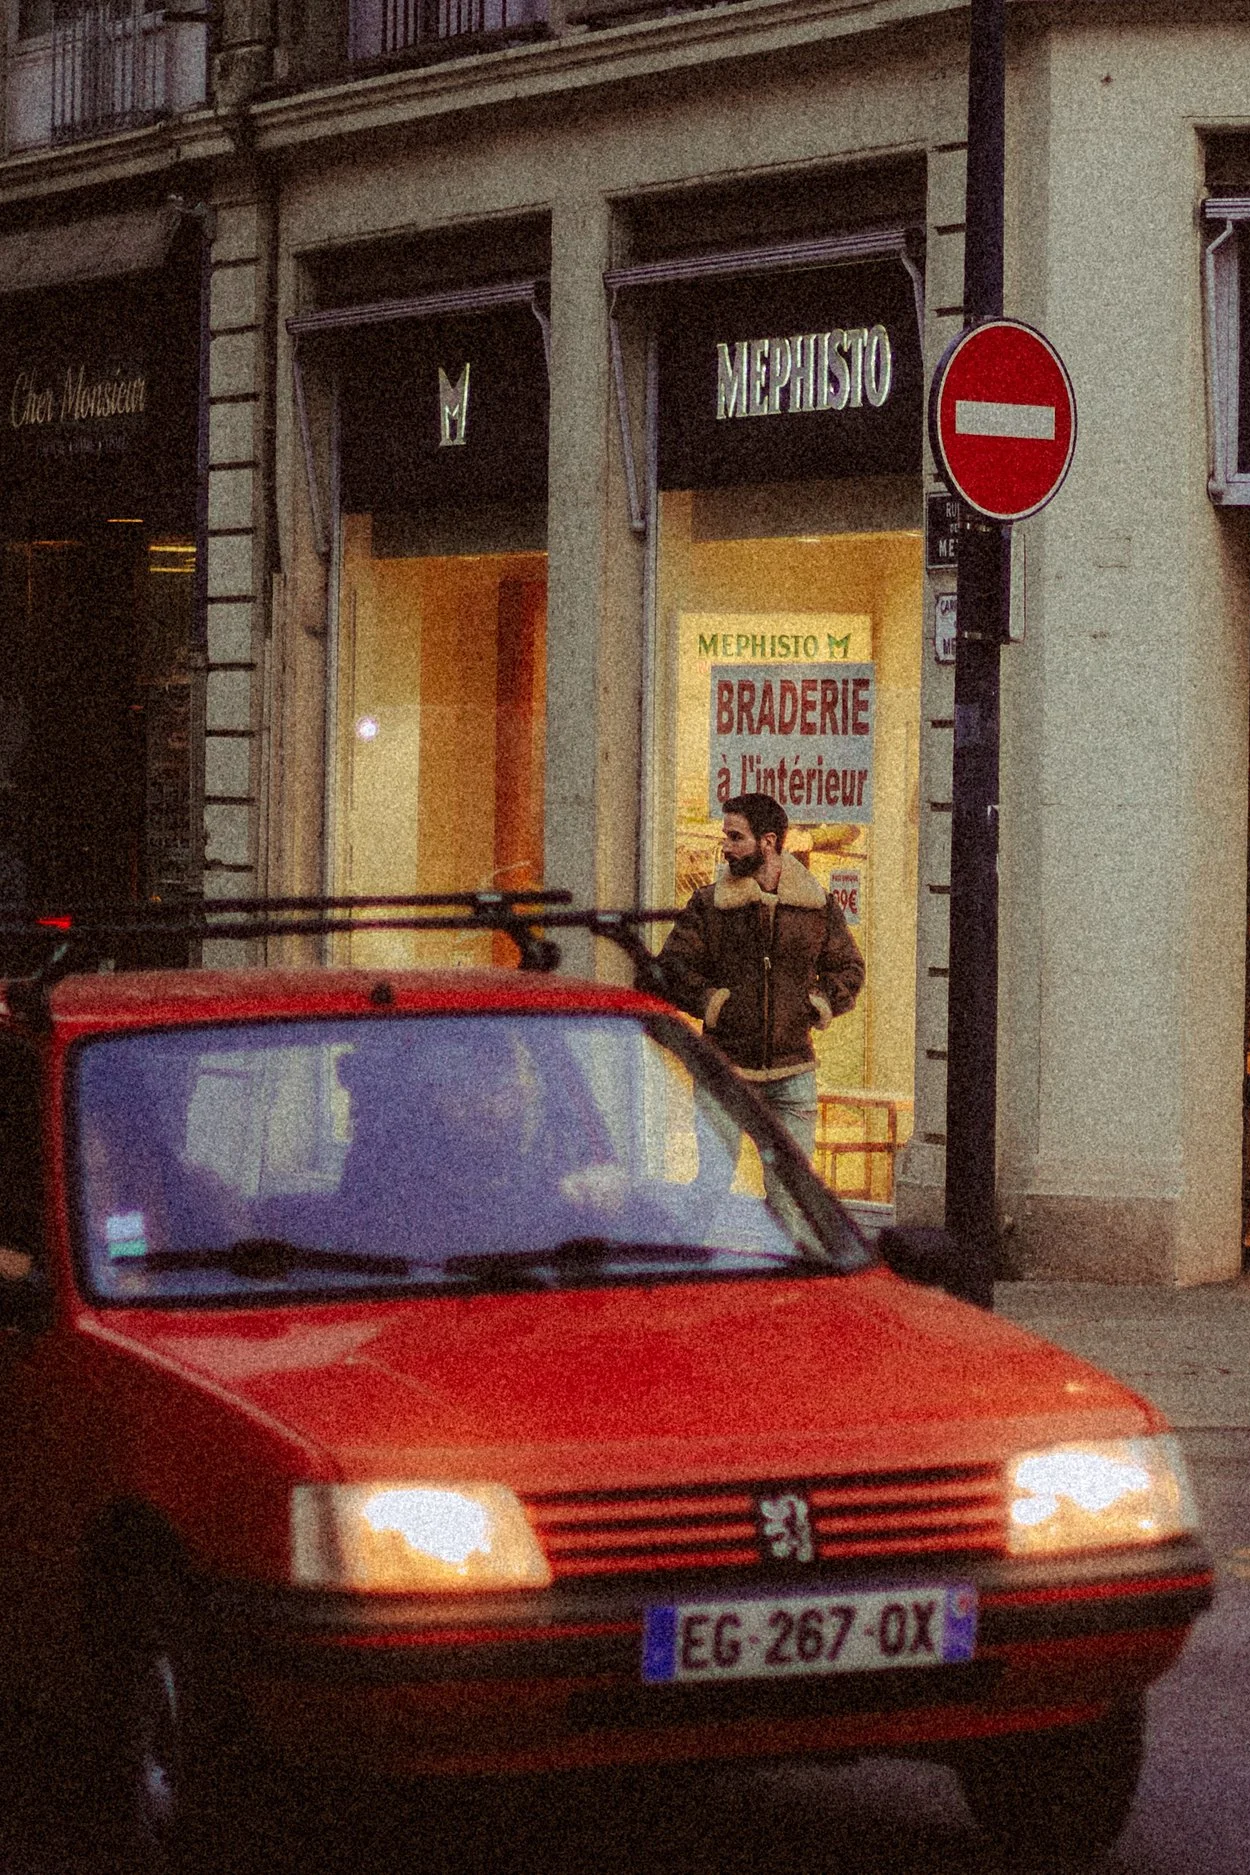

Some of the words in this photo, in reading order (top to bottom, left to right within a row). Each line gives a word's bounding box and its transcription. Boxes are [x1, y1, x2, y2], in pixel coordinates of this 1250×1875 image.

[60, 364, 145, 421] Monsieur
[716, 324, 892, 419] MEPHISTO
[698, 633, 818, 659] MEPHISTO
[715, 678, 870, 736] BRADERIE
[716, 754, 732, 804] à
[740, 755, 868, 807] l'intérieur
